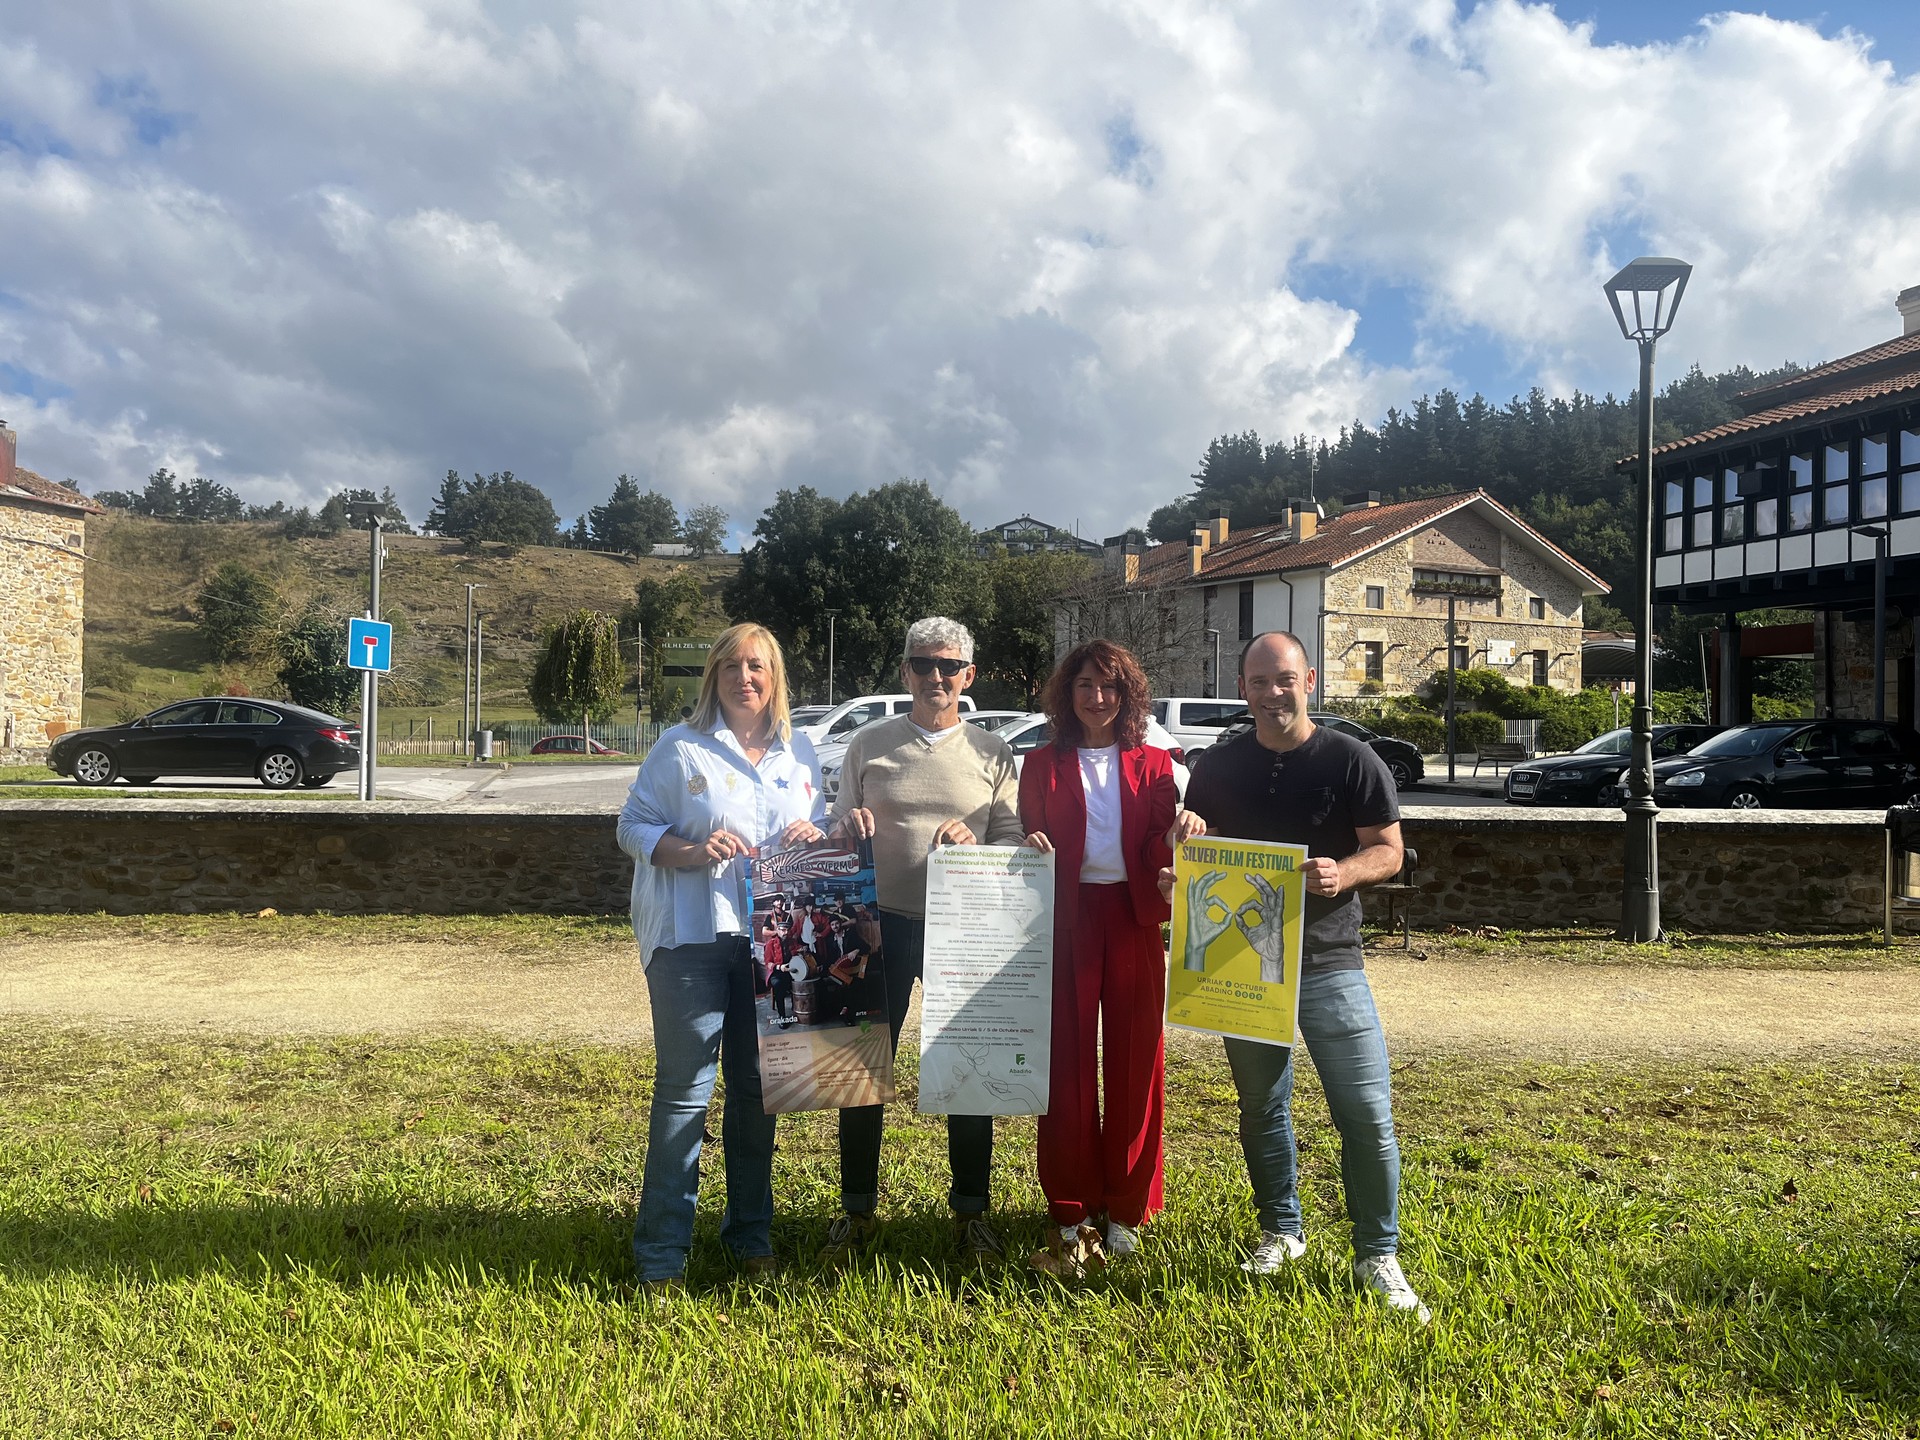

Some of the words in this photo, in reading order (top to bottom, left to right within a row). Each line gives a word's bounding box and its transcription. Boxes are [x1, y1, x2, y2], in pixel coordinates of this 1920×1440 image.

[943, 849, 978, 858] Adinekoen
[979, 851, 1018, 859] Nazioarteko
[1019, 852, 1040, 861] Eguna
[1182, 845, 1217, 864] SILVER
[1219, 849, 1244, 867] FILM
[1246, 852, 1295, 872] FESTIVAL
[1196, 976, 1224, 986] URRIAK
[1233, 982, 1268, 993] OCTUBRE
